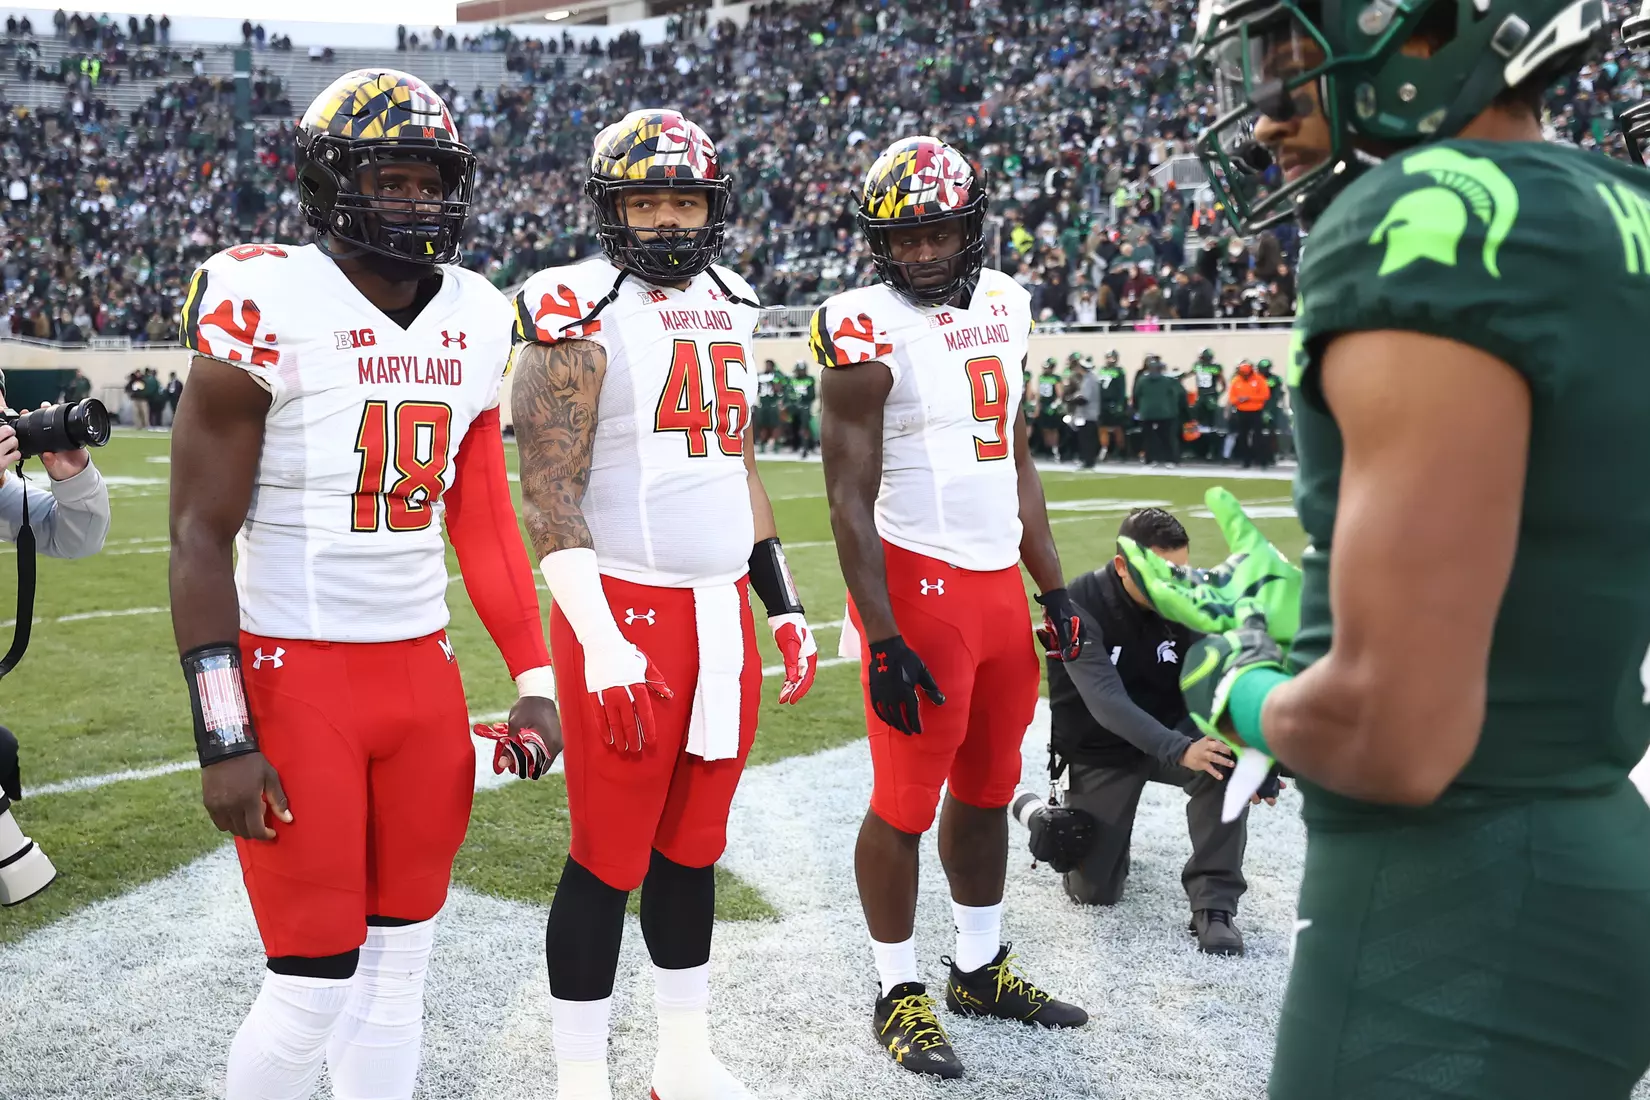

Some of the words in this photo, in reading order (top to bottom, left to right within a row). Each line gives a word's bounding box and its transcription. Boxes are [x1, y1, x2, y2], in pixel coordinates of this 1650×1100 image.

[422, 127, 436, 139] M
[664, 165, 677, 178] M
[913, 203, 925, 216] M
[659, 310, 732, 331] MARYLAND
[944, 324, 1009, 351] MARYLAND
[358, 356, 462, 386] MARYLAND
[653, 339, 749, 457] 46
[965, 355, 1009, 461] 9
[350, 400, 452, 532] 18
